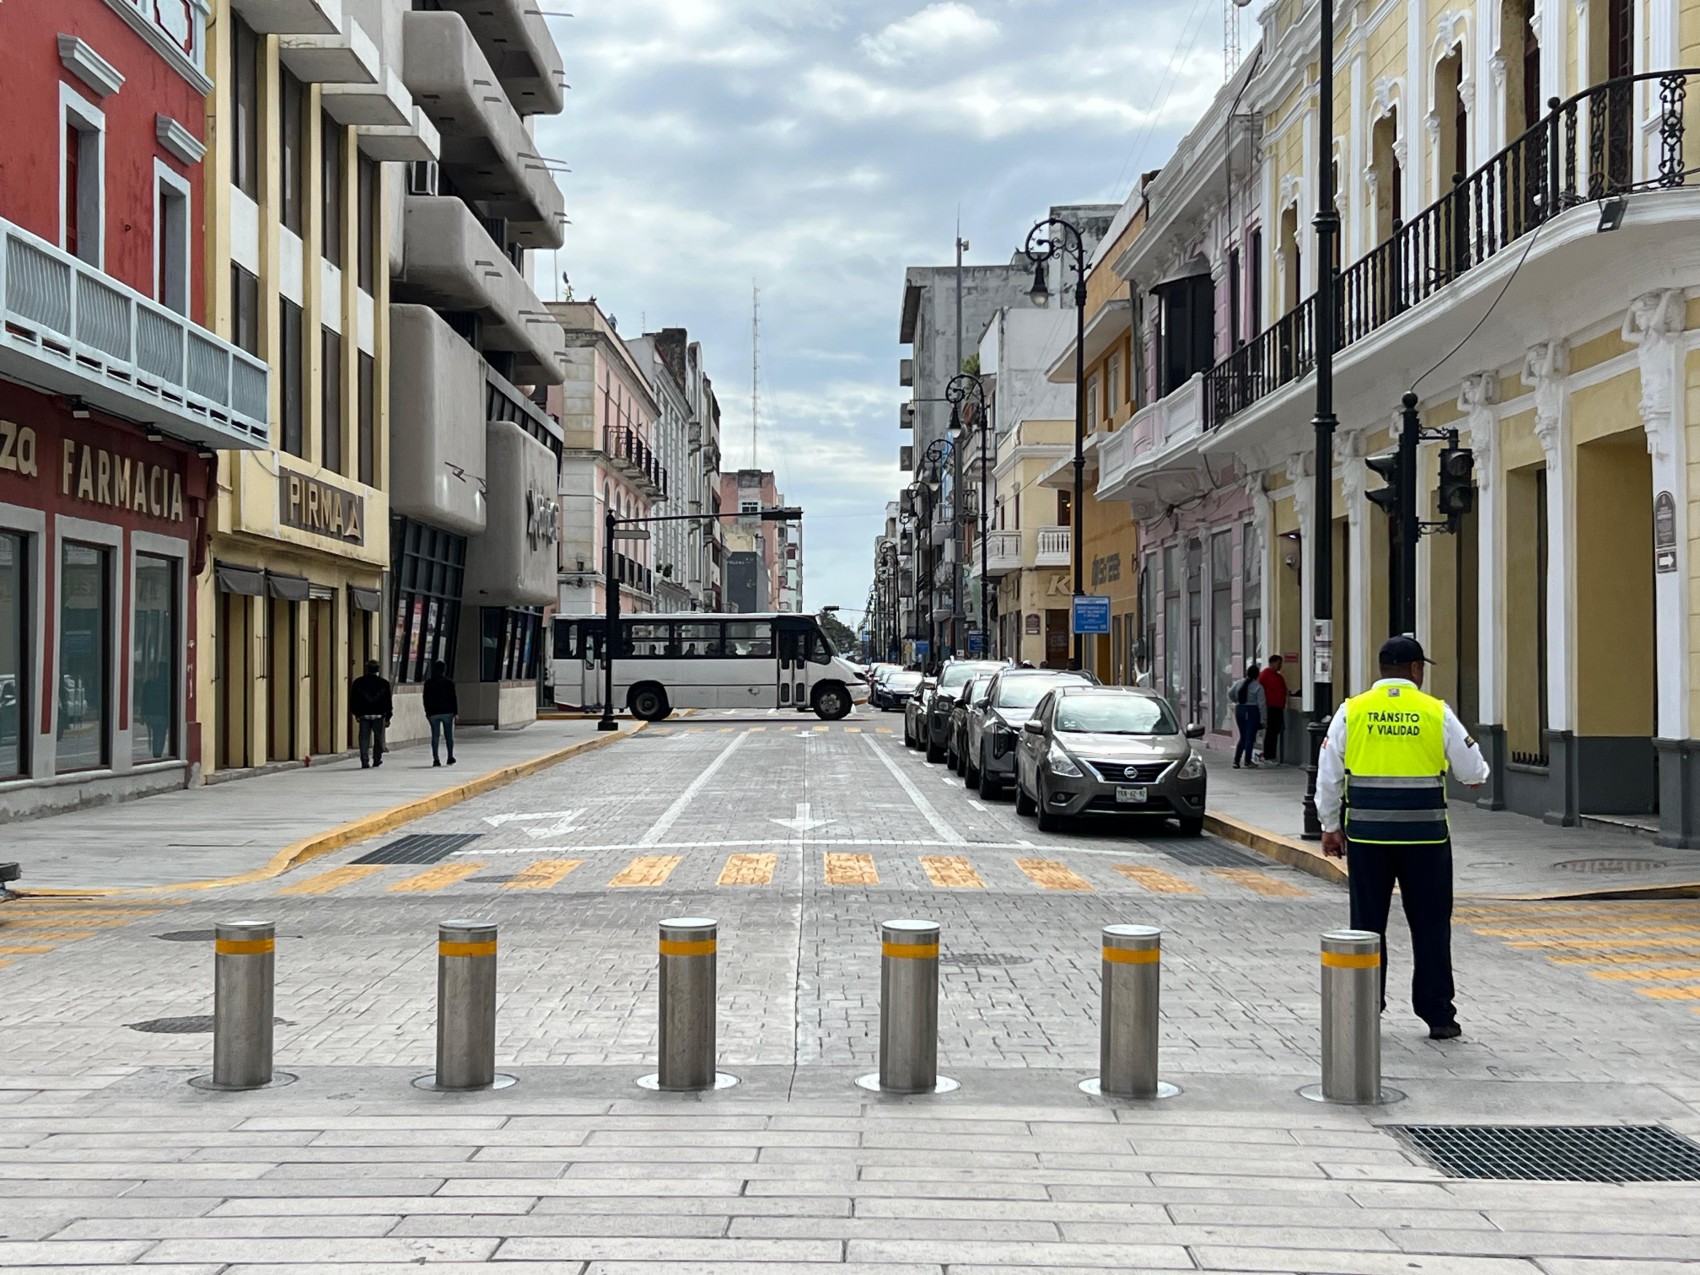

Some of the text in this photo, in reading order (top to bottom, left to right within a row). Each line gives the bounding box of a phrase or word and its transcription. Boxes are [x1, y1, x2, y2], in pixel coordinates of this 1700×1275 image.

[62, 438, 183, 522] FARMACIA
[289, 475, 345, 533] PIRMA
[1367, 710, 1420, 723] TRÁNSITO
[1367, 724, 1420, 736] Y VIALIDAD
